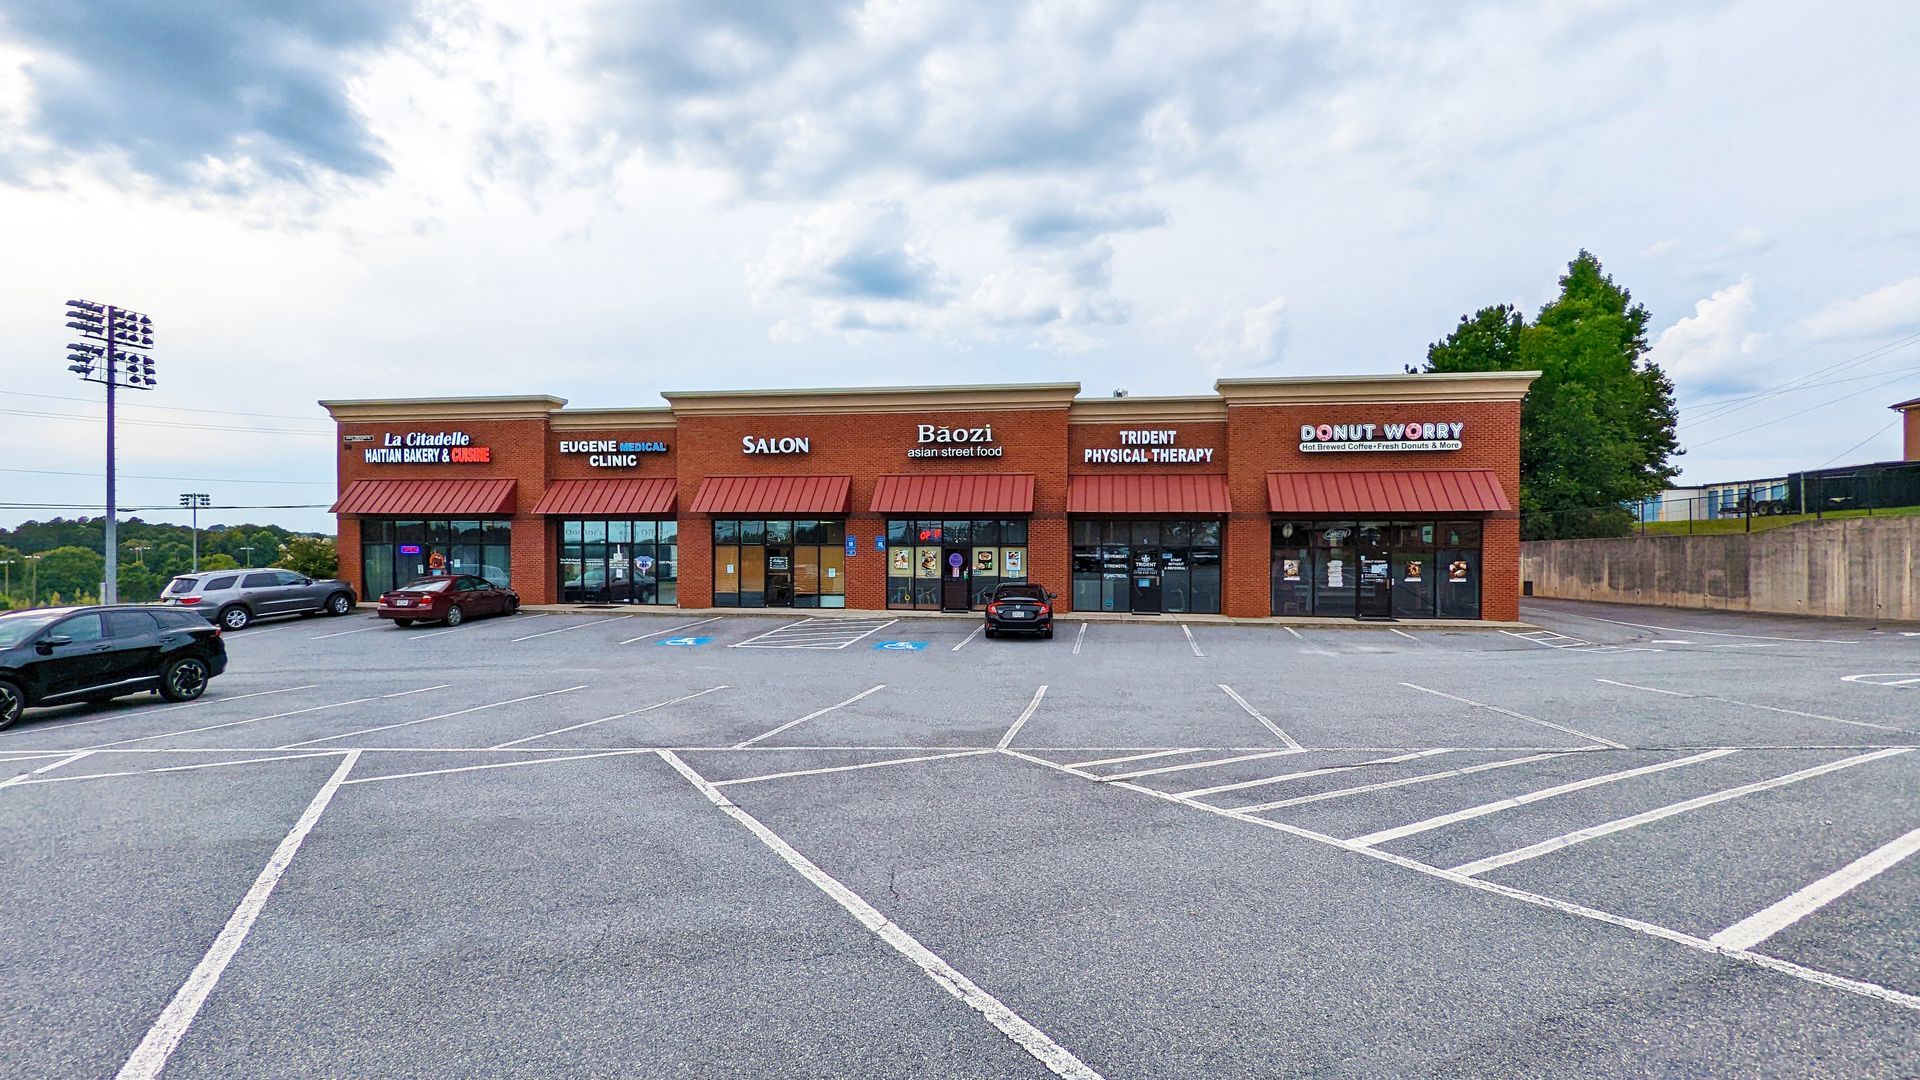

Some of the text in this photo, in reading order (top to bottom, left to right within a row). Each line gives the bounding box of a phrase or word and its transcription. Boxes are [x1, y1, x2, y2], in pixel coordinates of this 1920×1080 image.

[1120, 431, 1176, 444] TRIDENT
[1301, 422, 1463, 441] DONUT WORRY
[384, 433, 402, 446] La
[406, 432, 469, 446] Citadelle
[742, 436, 809, 453] SALON
[560, 441, 666, 452] EUGENE MEDICAL
[907, 446, 1002, 457] asian street food
[365, 447, 490, 463] HAITIAN BAKERY & CUISINE
[589, 455, 637, 467] CLINIC
[1084, 448, 1214, 463] PHYSICAL THERAPY
